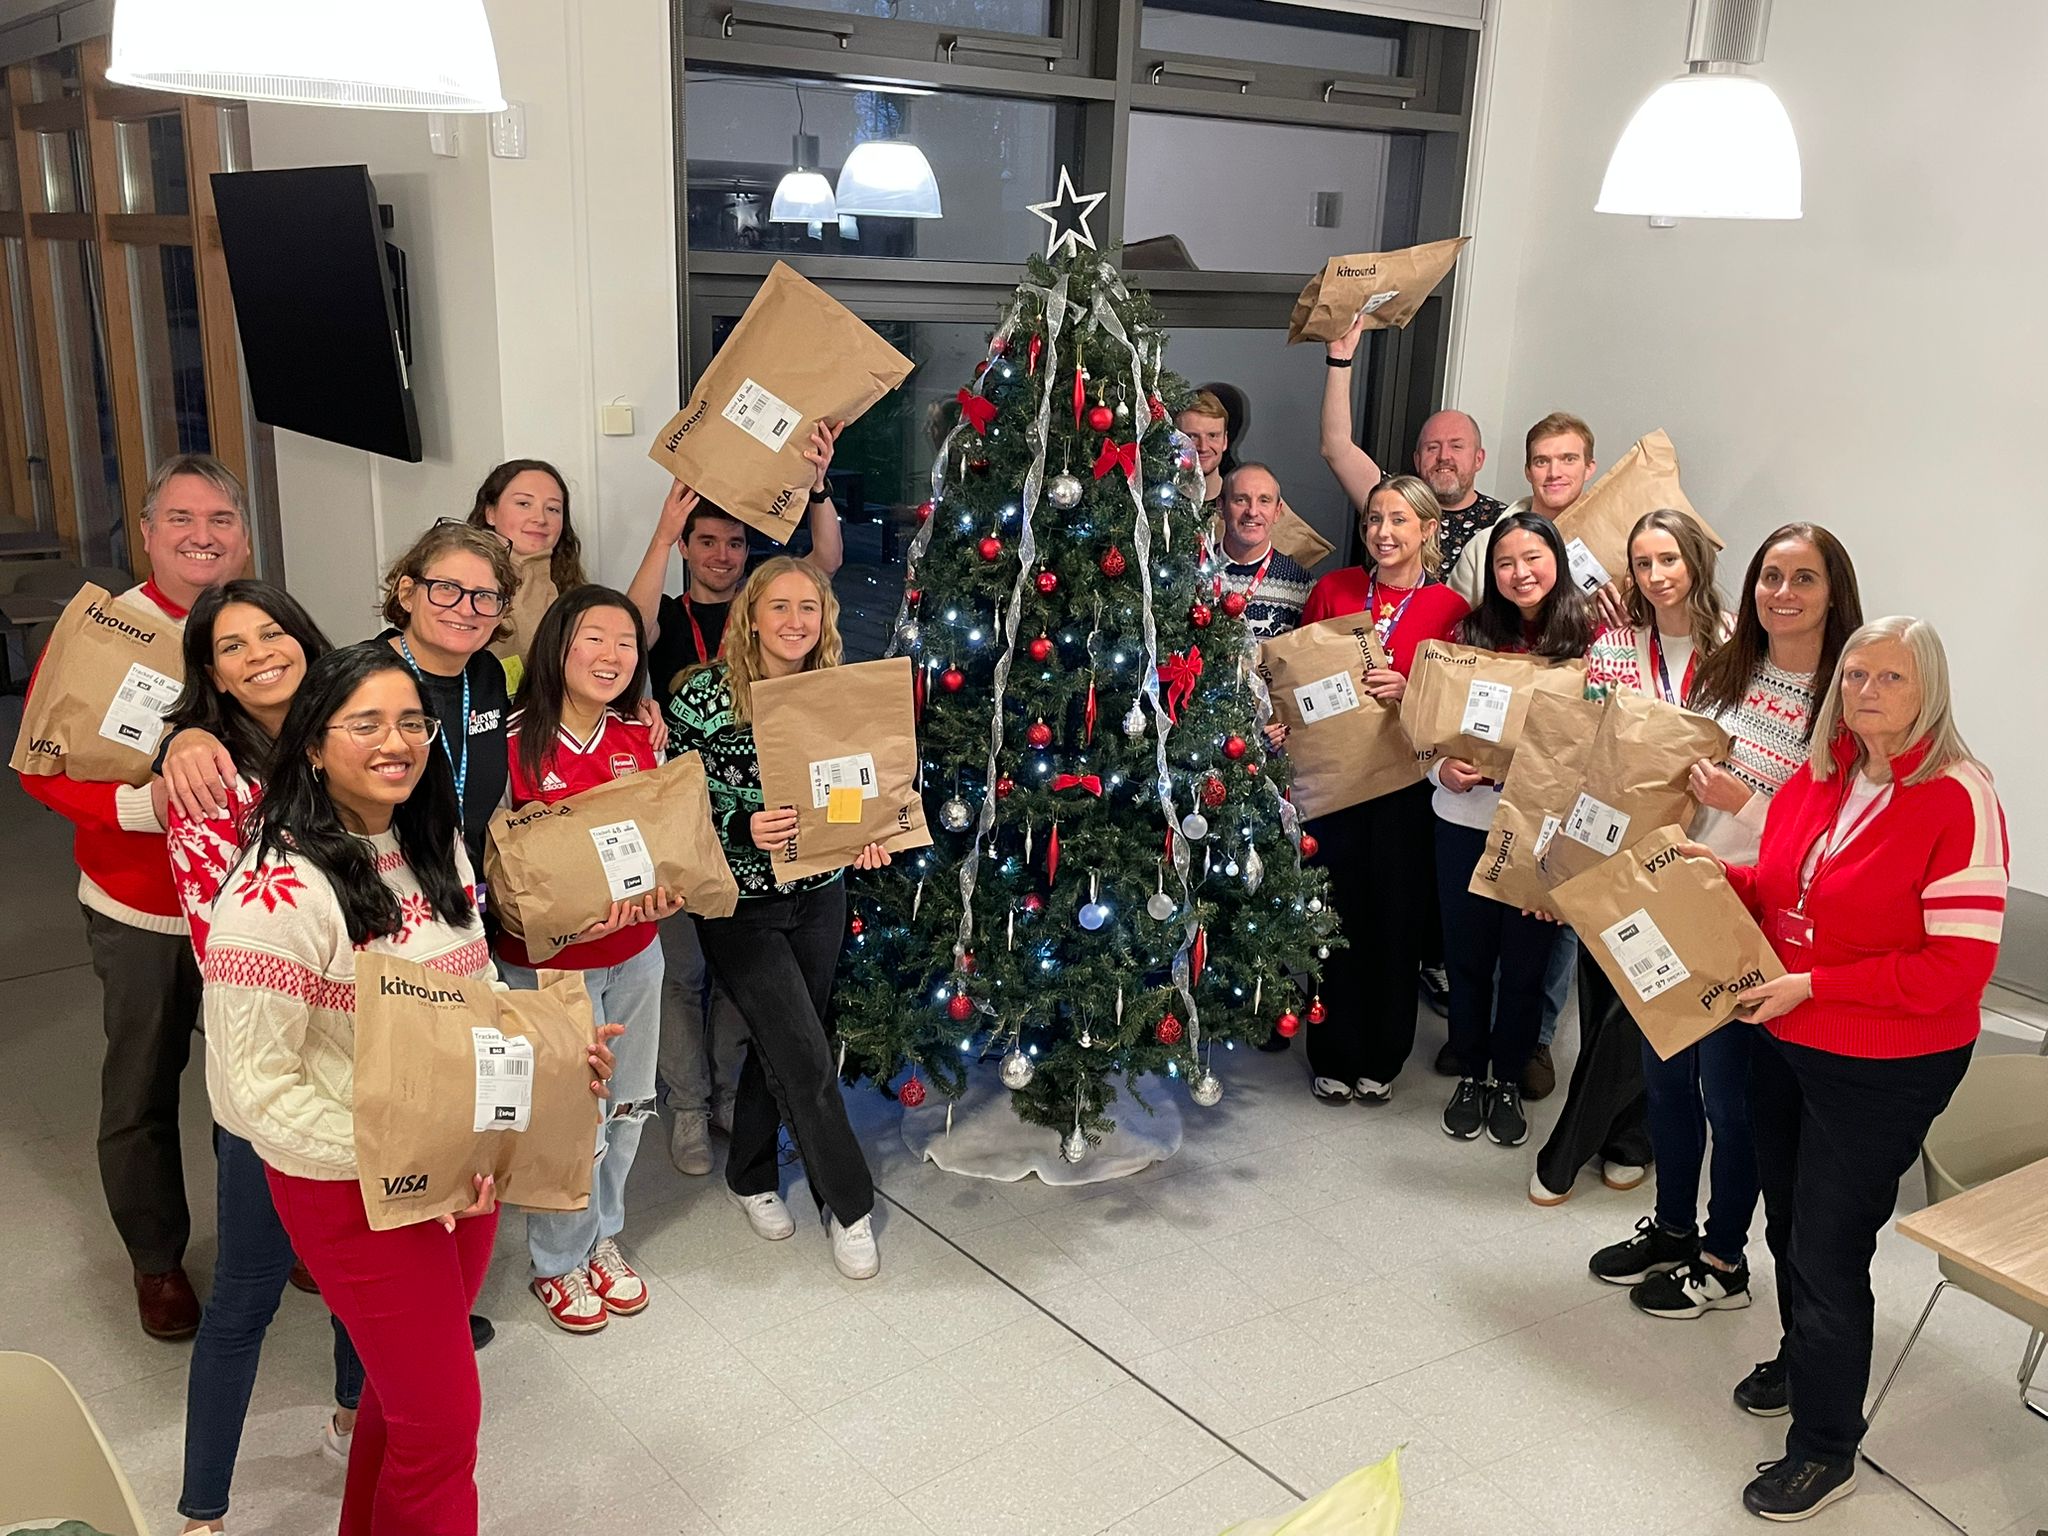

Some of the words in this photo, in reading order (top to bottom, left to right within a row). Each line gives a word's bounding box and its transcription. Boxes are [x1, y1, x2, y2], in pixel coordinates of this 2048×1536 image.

[665, 400, 708, 453] kitround
[767, 489, 793, 516] VISA
[85, 602, 156, 644] kitround
[153, 676, 166, 687] 48
[1258, 661, 1274, 686] VISA
[469, 718, 499, 736] ENGLAND
[30, 736, 62, 757] VISA
[1485, 830, 1514, 882] kitround
[1645, 847, 1682, 874] VISA
[550, 932, 578, 947] VIS
[380, 975, 466, 1003] kitround
[376, 1174, 428, 1196] VISA
